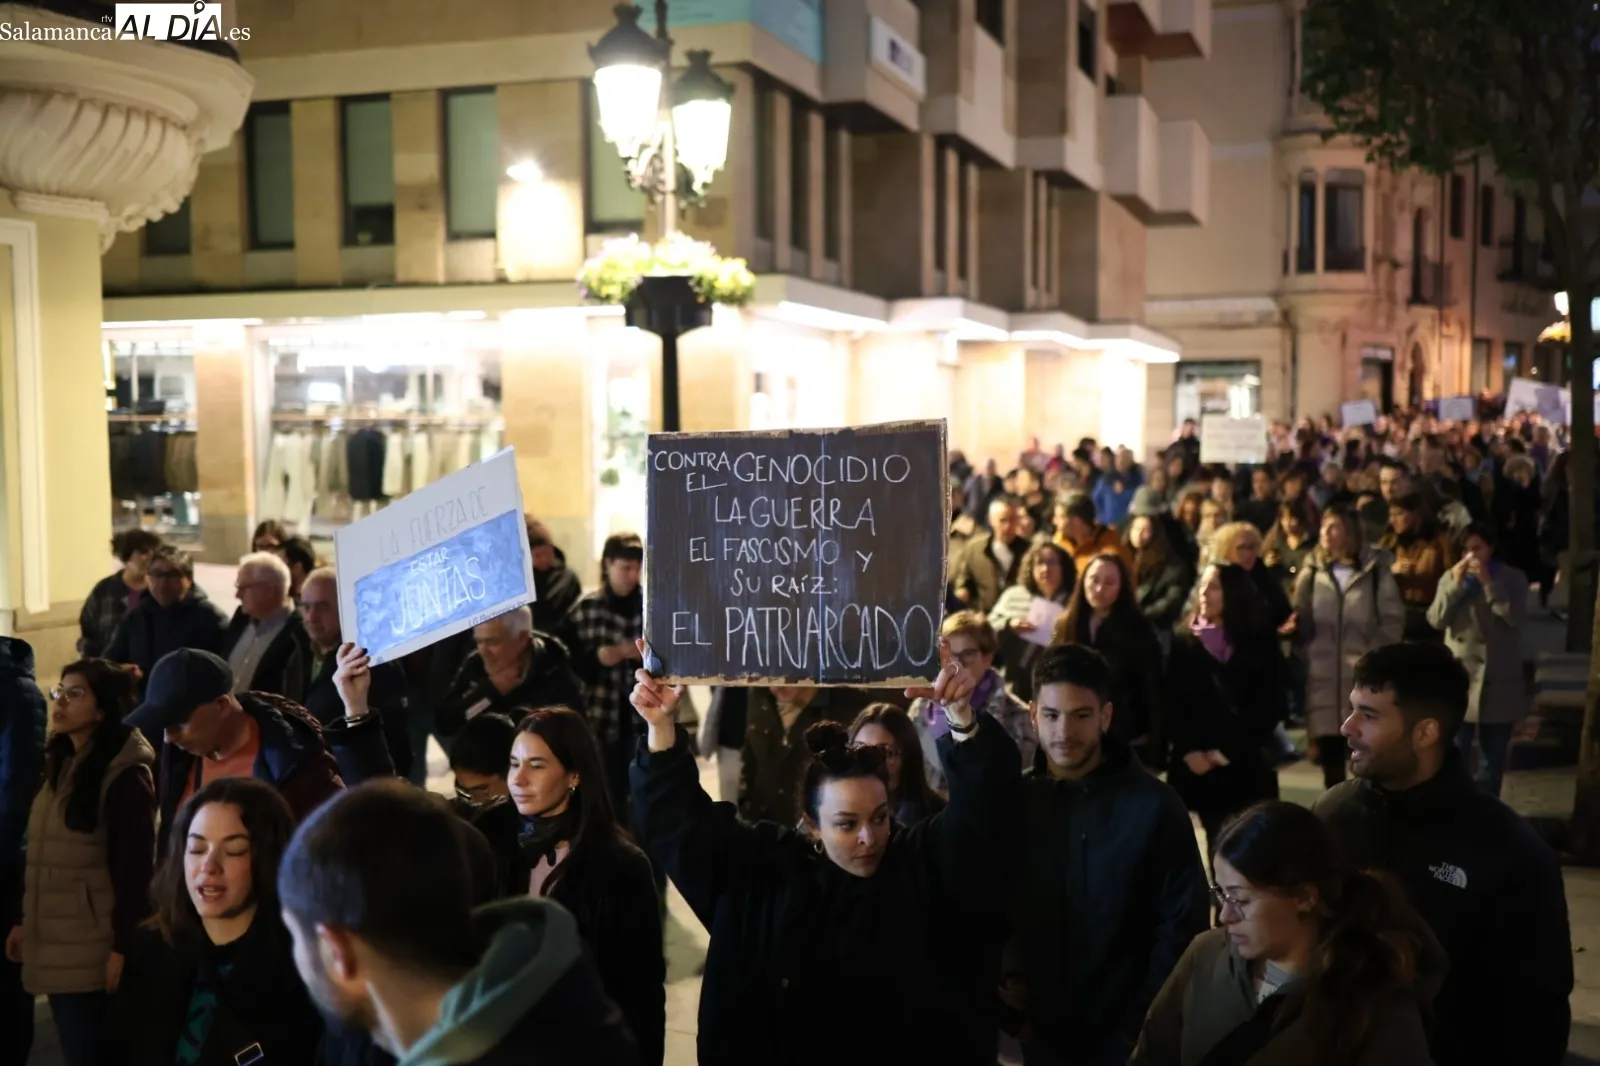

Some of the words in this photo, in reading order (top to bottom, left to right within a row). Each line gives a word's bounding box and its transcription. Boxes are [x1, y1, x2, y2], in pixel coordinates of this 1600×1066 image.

[654, 449, 731, 471] CONTRA
[734, 452, 911, 485] GENOCIDIO
[686, 472, 728, 492] EL
[379, 527, 401, 563] LA
[408, 497, 468, 550] FUERZA
[470, 485, 490, 522] DE
[715, 496, 746, 525] LA
[750, 496, 876, 536] GUERRA
[409, 547, 450, 575] ESTAR
[689, 536, 715, 563] EL
[724, 536, 840, 566] FASCISMO
[856, 550, 873, 573] Y
[391, 557, 487, 635] JUNTAS
[730, 568, 761, 597] SU
[672, 611, 712, 646] EL
[725, 603, 934, 671] PATRIARCADO
[1428, 864, 1455, 877] NORTH
[1433, 871, 1456, 883] FACE
[1441, 861, 1456, 872] THE
